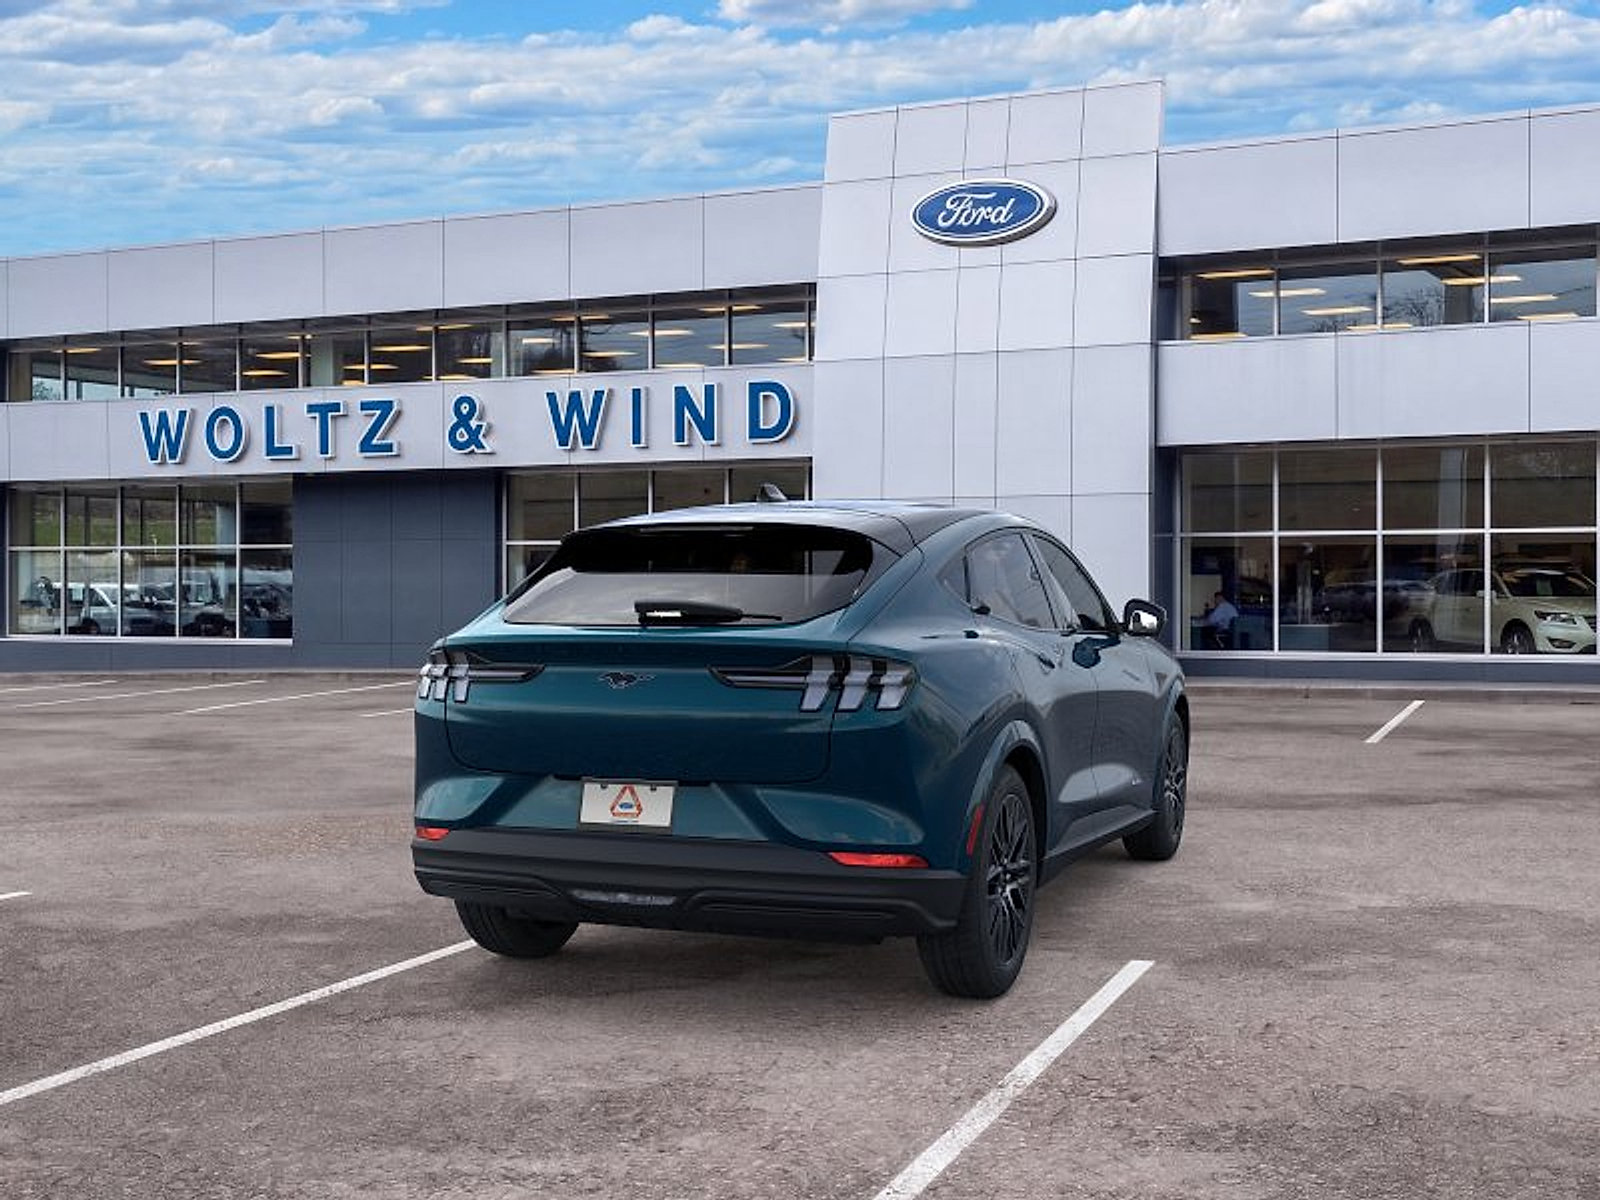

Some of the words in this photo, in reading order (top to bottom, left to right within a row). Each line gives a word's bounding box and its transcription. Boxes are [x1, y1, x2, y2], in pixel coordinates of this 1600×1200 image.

[937, 191, 1016, 229] Ford
[138, 398, 402, 464] WOLTZ
[447, 394, 492, 453] &
[545, 379, 796, 450] WIND
